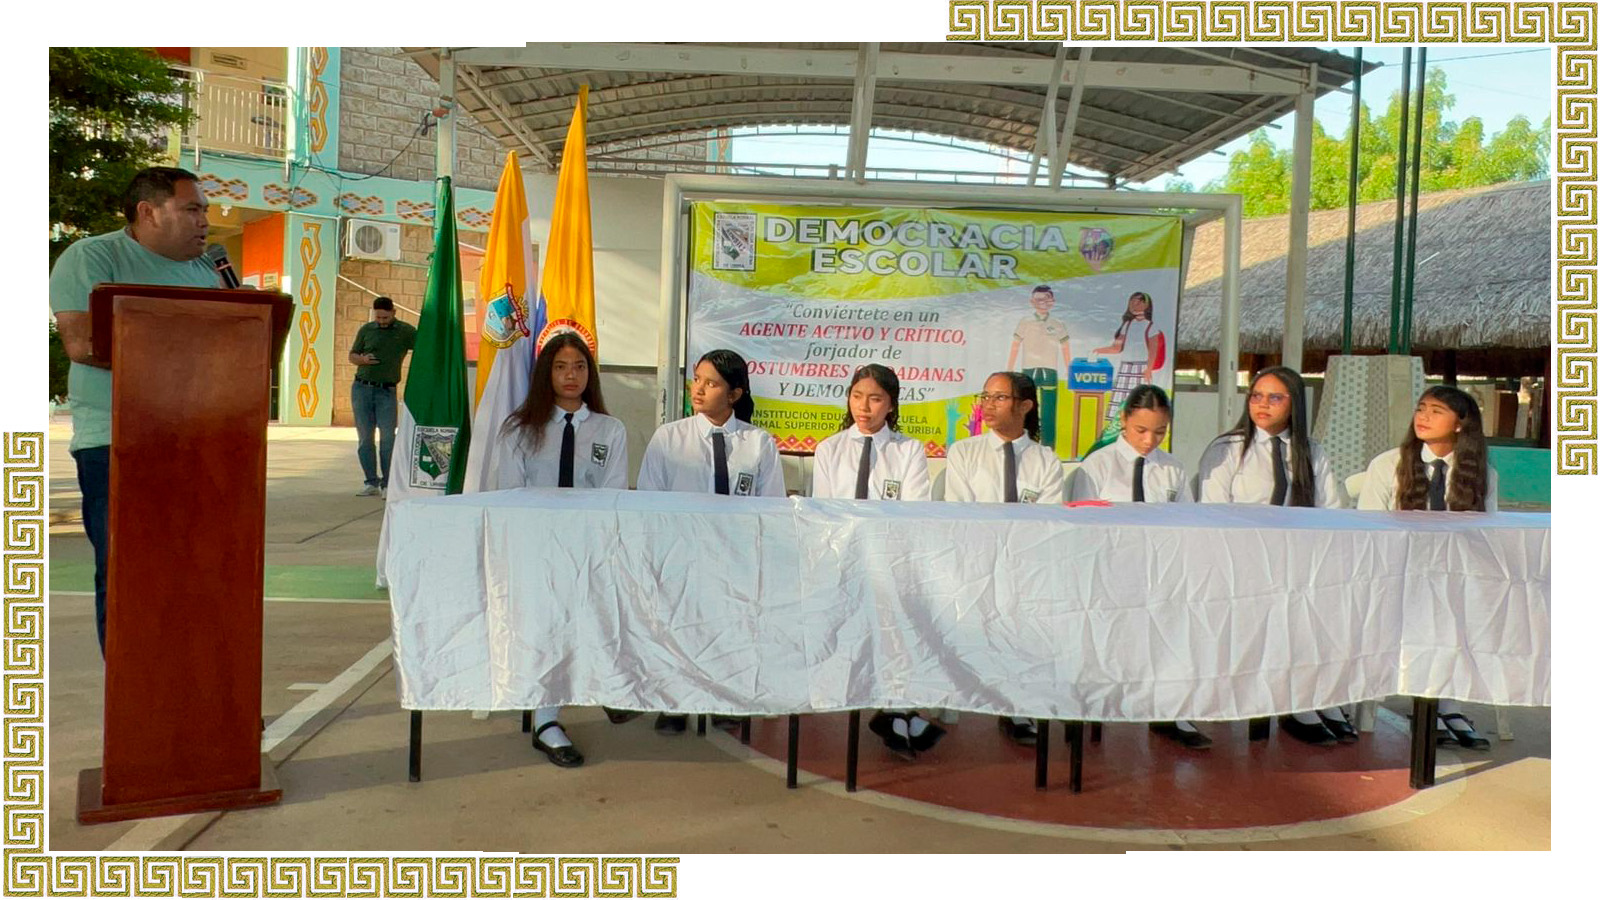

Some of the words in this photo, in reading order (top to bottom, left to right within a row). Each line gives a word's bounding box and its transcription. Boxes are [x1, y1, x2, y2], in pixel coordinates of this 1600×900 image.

[764, 216, 1069, 252] DEMOCRACIA
[811, 247, 1019, 279] ESCOLAR
[893, 310, 913, 322] en
[918, 312, 940, 323] un
[739, 322, 808, 338] AGENTE
[812, 325, 874, 341] ACTIVO
[880, 326, 890, 341] Y
[894, 324, 967, 346] CRÍTICO,
[804, 342, 877, 361] forjador
[882, 345, 902, 360] de
[747, 360, 850, 378] OSTUMBRES
[1074, 372, 1107, 384] VOTE
[780, 382, 789, 396] Y
[784, 421, 835, 431] SUPERIOR
[907, 426, 942, 435] URIBIA
